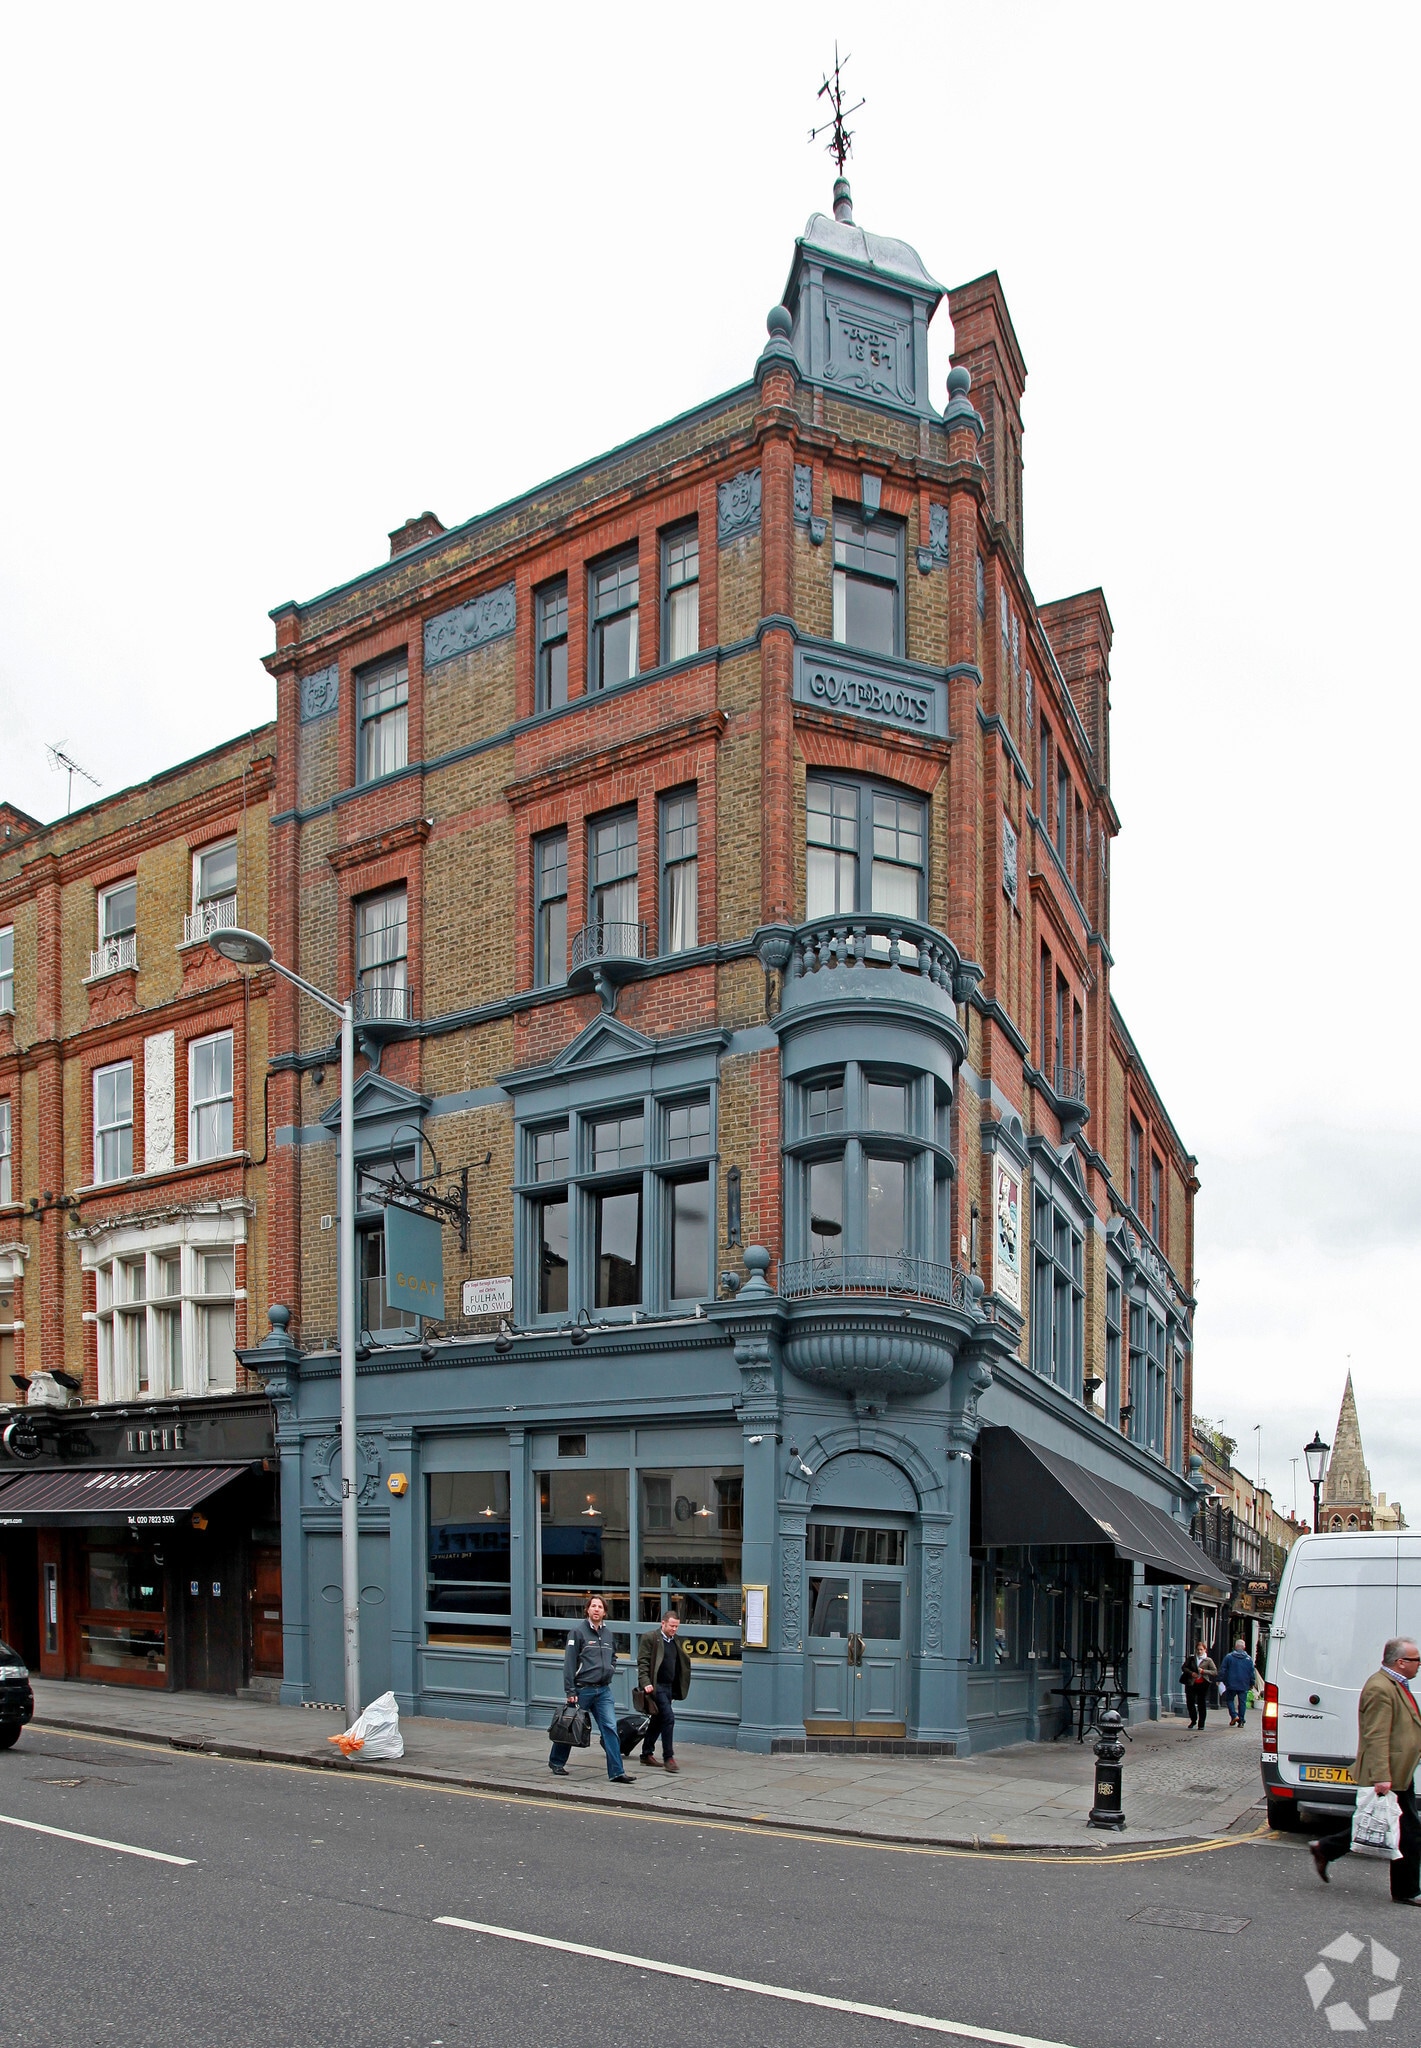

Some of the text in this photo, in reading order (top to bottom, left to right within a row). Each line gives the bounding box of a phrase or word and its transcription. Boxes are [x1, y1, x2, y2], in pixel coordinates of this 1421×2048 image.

[810, 673, 862, 707] GOAT
[865, 682, 929, 724] BOOTS
[396, 1271, 438, 1297] GOAT
[470, 1292, 505, 1304] FULHAM
[465, 1303, 489, 1314] ROAD
[681, 1639, 734, 1657] GOAT
[1308, 1767, 1342, 1781] DE57
